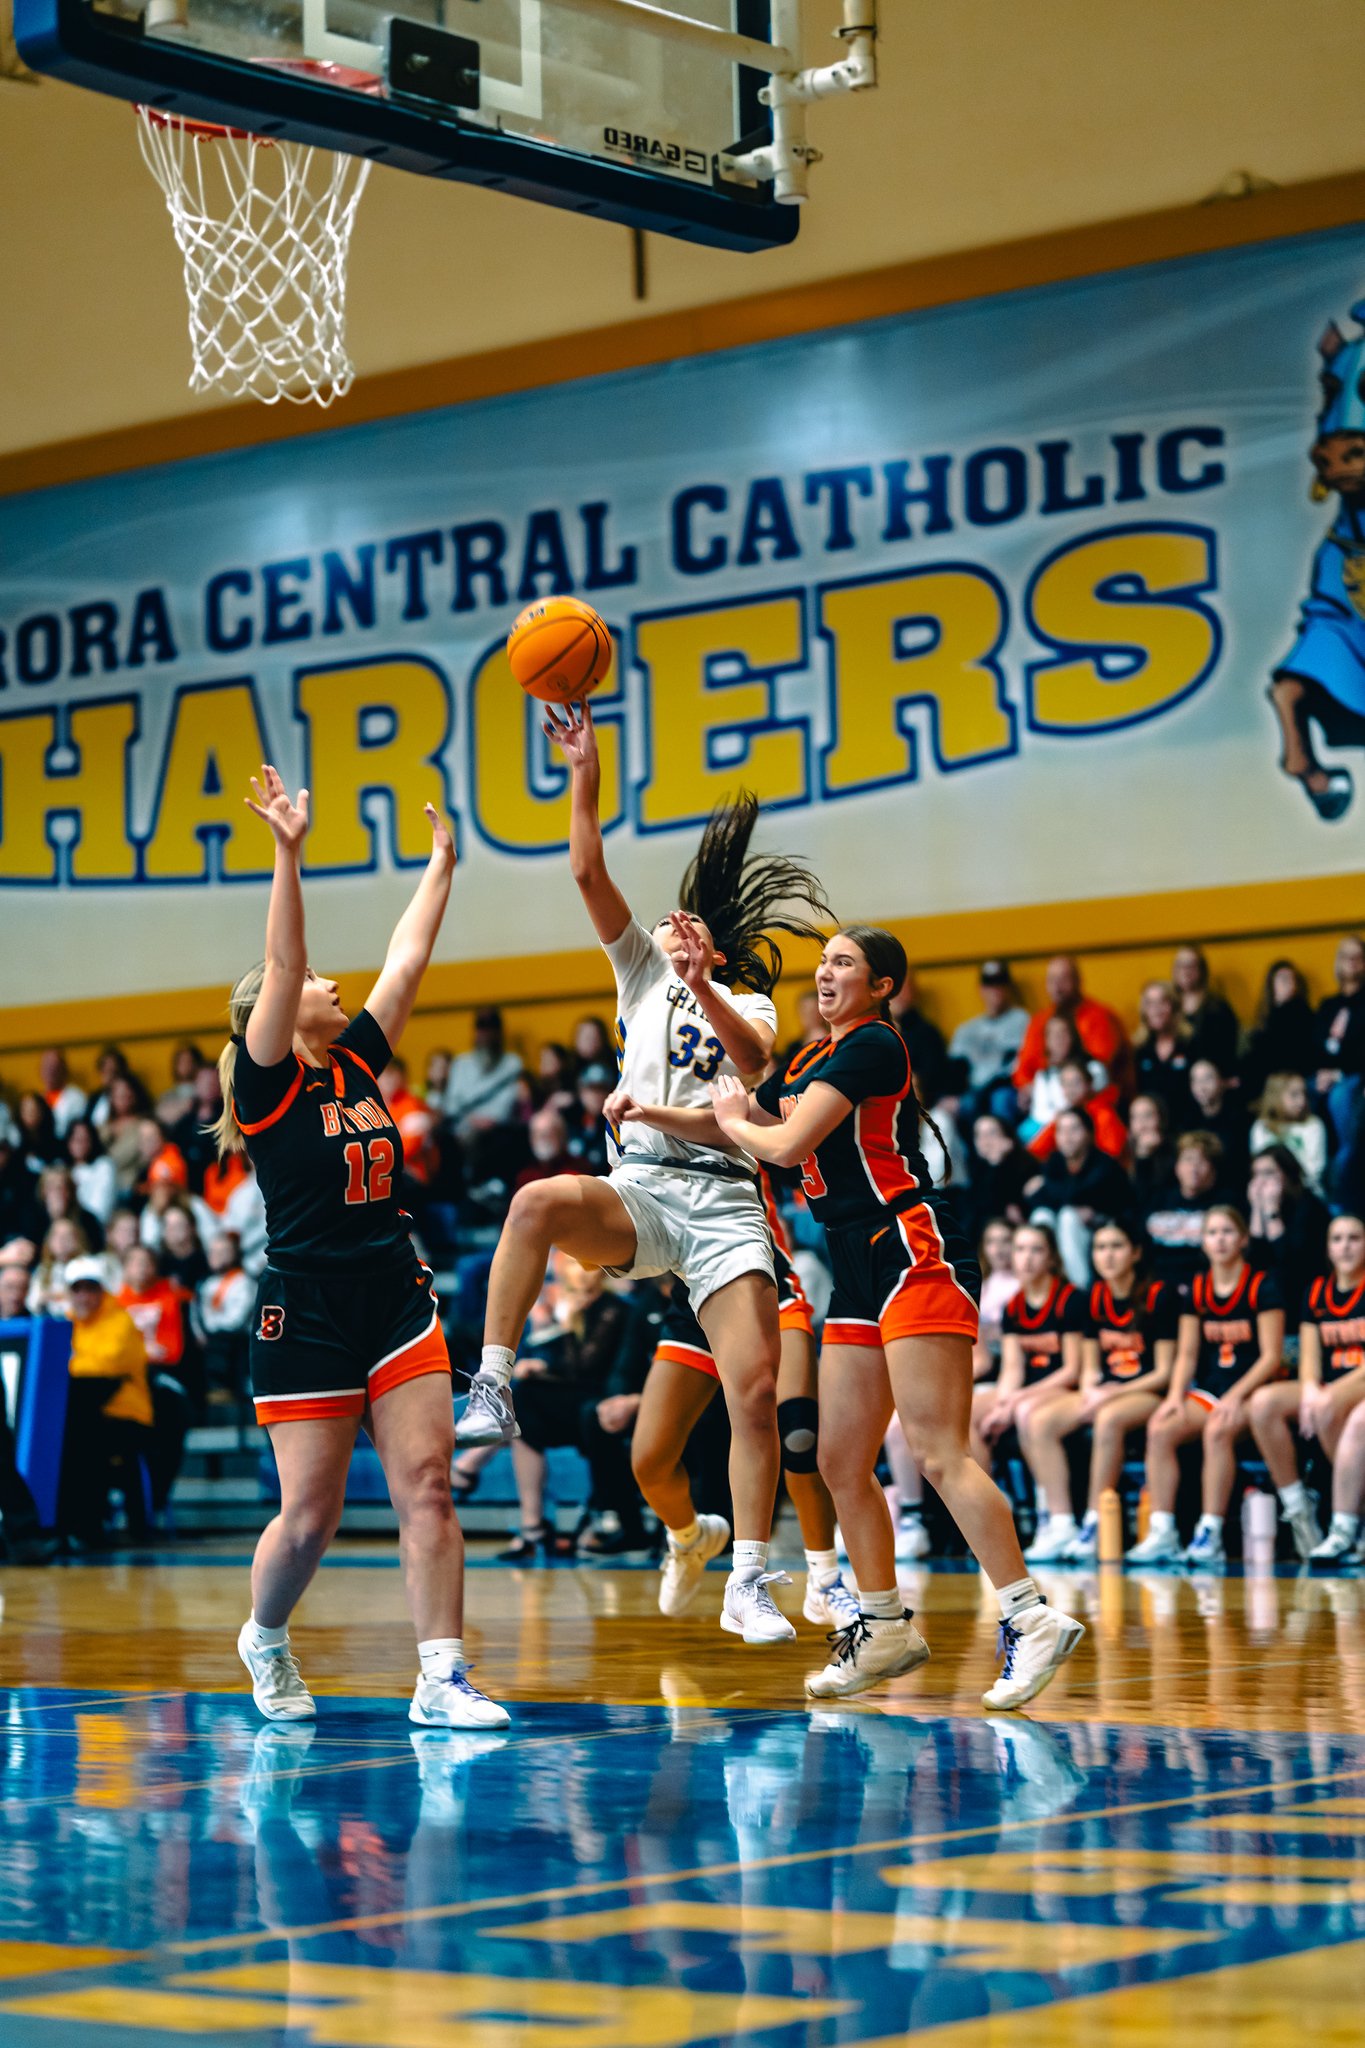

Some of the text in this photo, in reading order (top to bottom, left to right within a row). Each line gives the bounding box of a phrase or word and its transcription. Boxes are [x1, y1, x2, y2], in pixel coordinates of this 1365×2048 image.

[0, 425, 1227, 691] ORA CENTRAL CATHOLIC
[0, 520, 1223, 888] HARGERS
[667, 1023, 727, 1082] 33
[343, 1137, 395, 1205] 12
